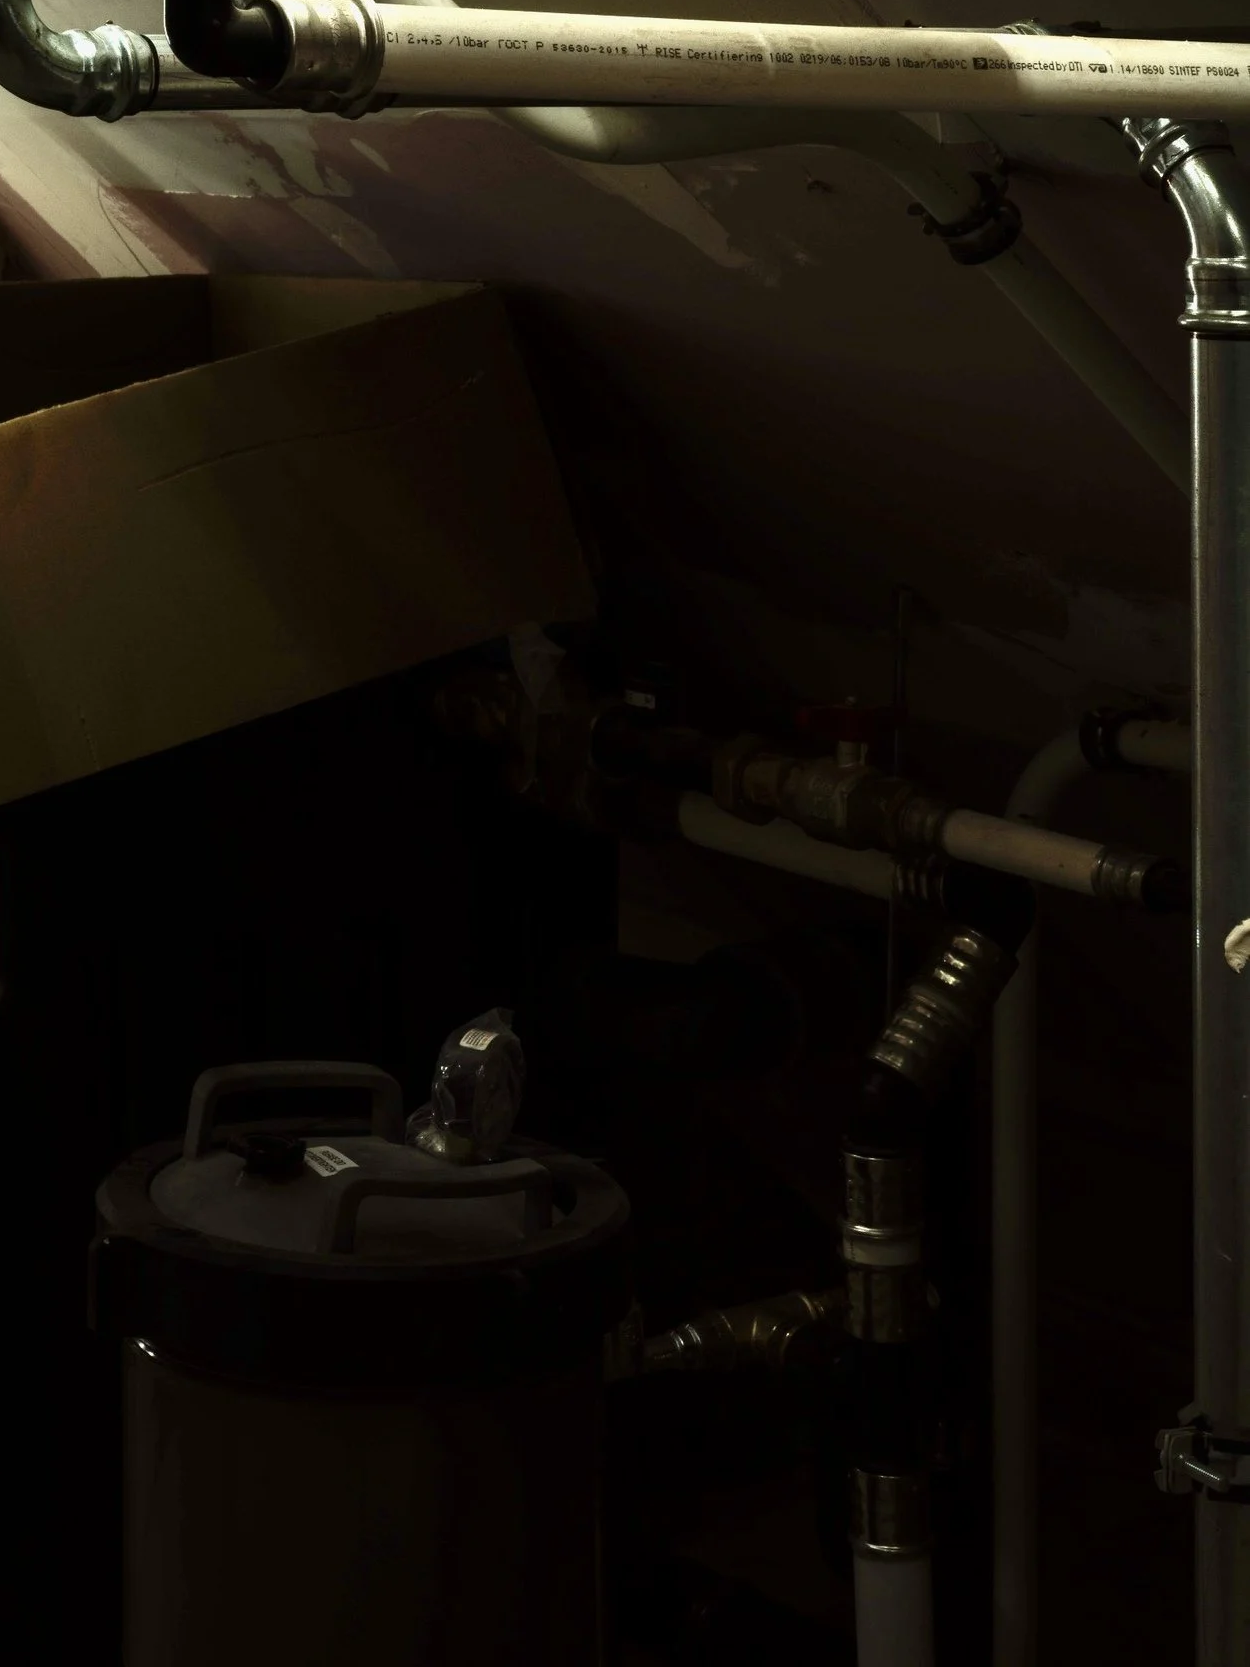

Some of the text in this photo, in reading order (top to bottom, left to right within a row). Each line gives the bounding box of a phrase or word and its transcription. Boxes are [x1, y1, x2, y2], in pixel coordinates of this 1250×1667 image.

[655, 47, 682, 59] RISE
[687, 48, 763, 63] Certifiering
[770, 52, 794, 64] 1002
[1169, 64, 1201, 76] SINTEF
[1206, 66, 1240, 78] PS0024
